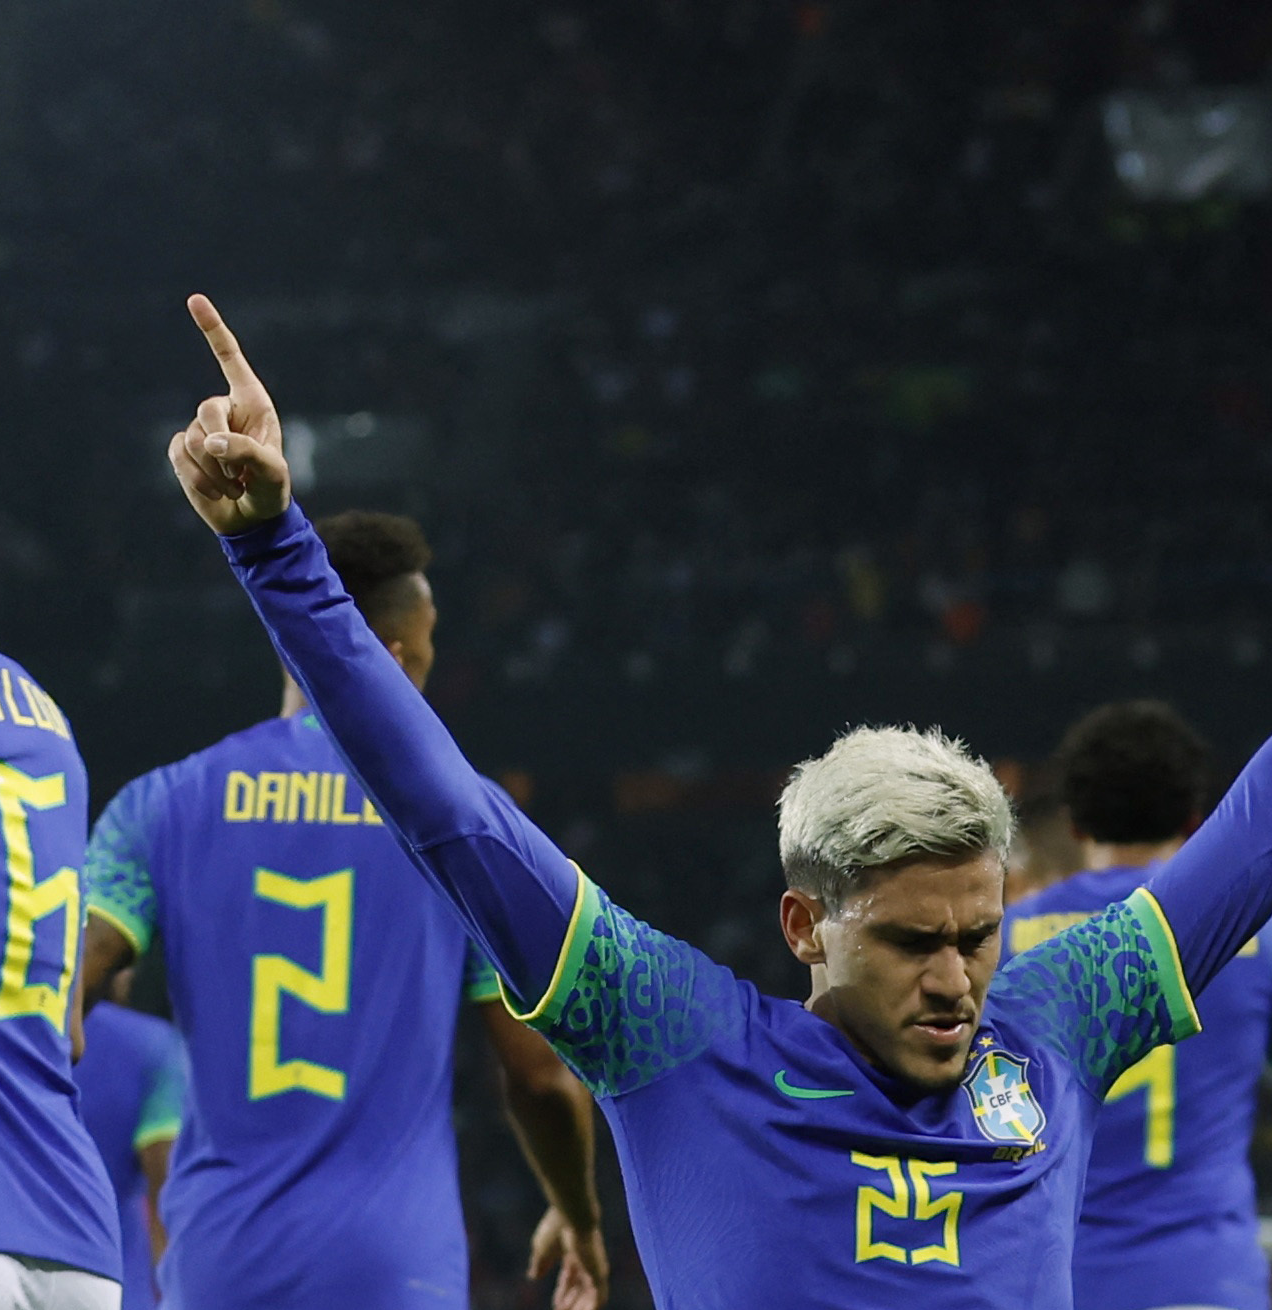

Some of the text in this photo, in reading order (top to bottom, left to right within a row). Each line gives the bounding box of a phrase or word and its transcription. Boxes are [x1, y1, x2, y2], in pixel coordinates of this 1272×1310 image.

[248, 866, 356, 1102] 2
[989, 1090, 1013, 1109] CBF
[850, 1150, 963, 1267] 25
